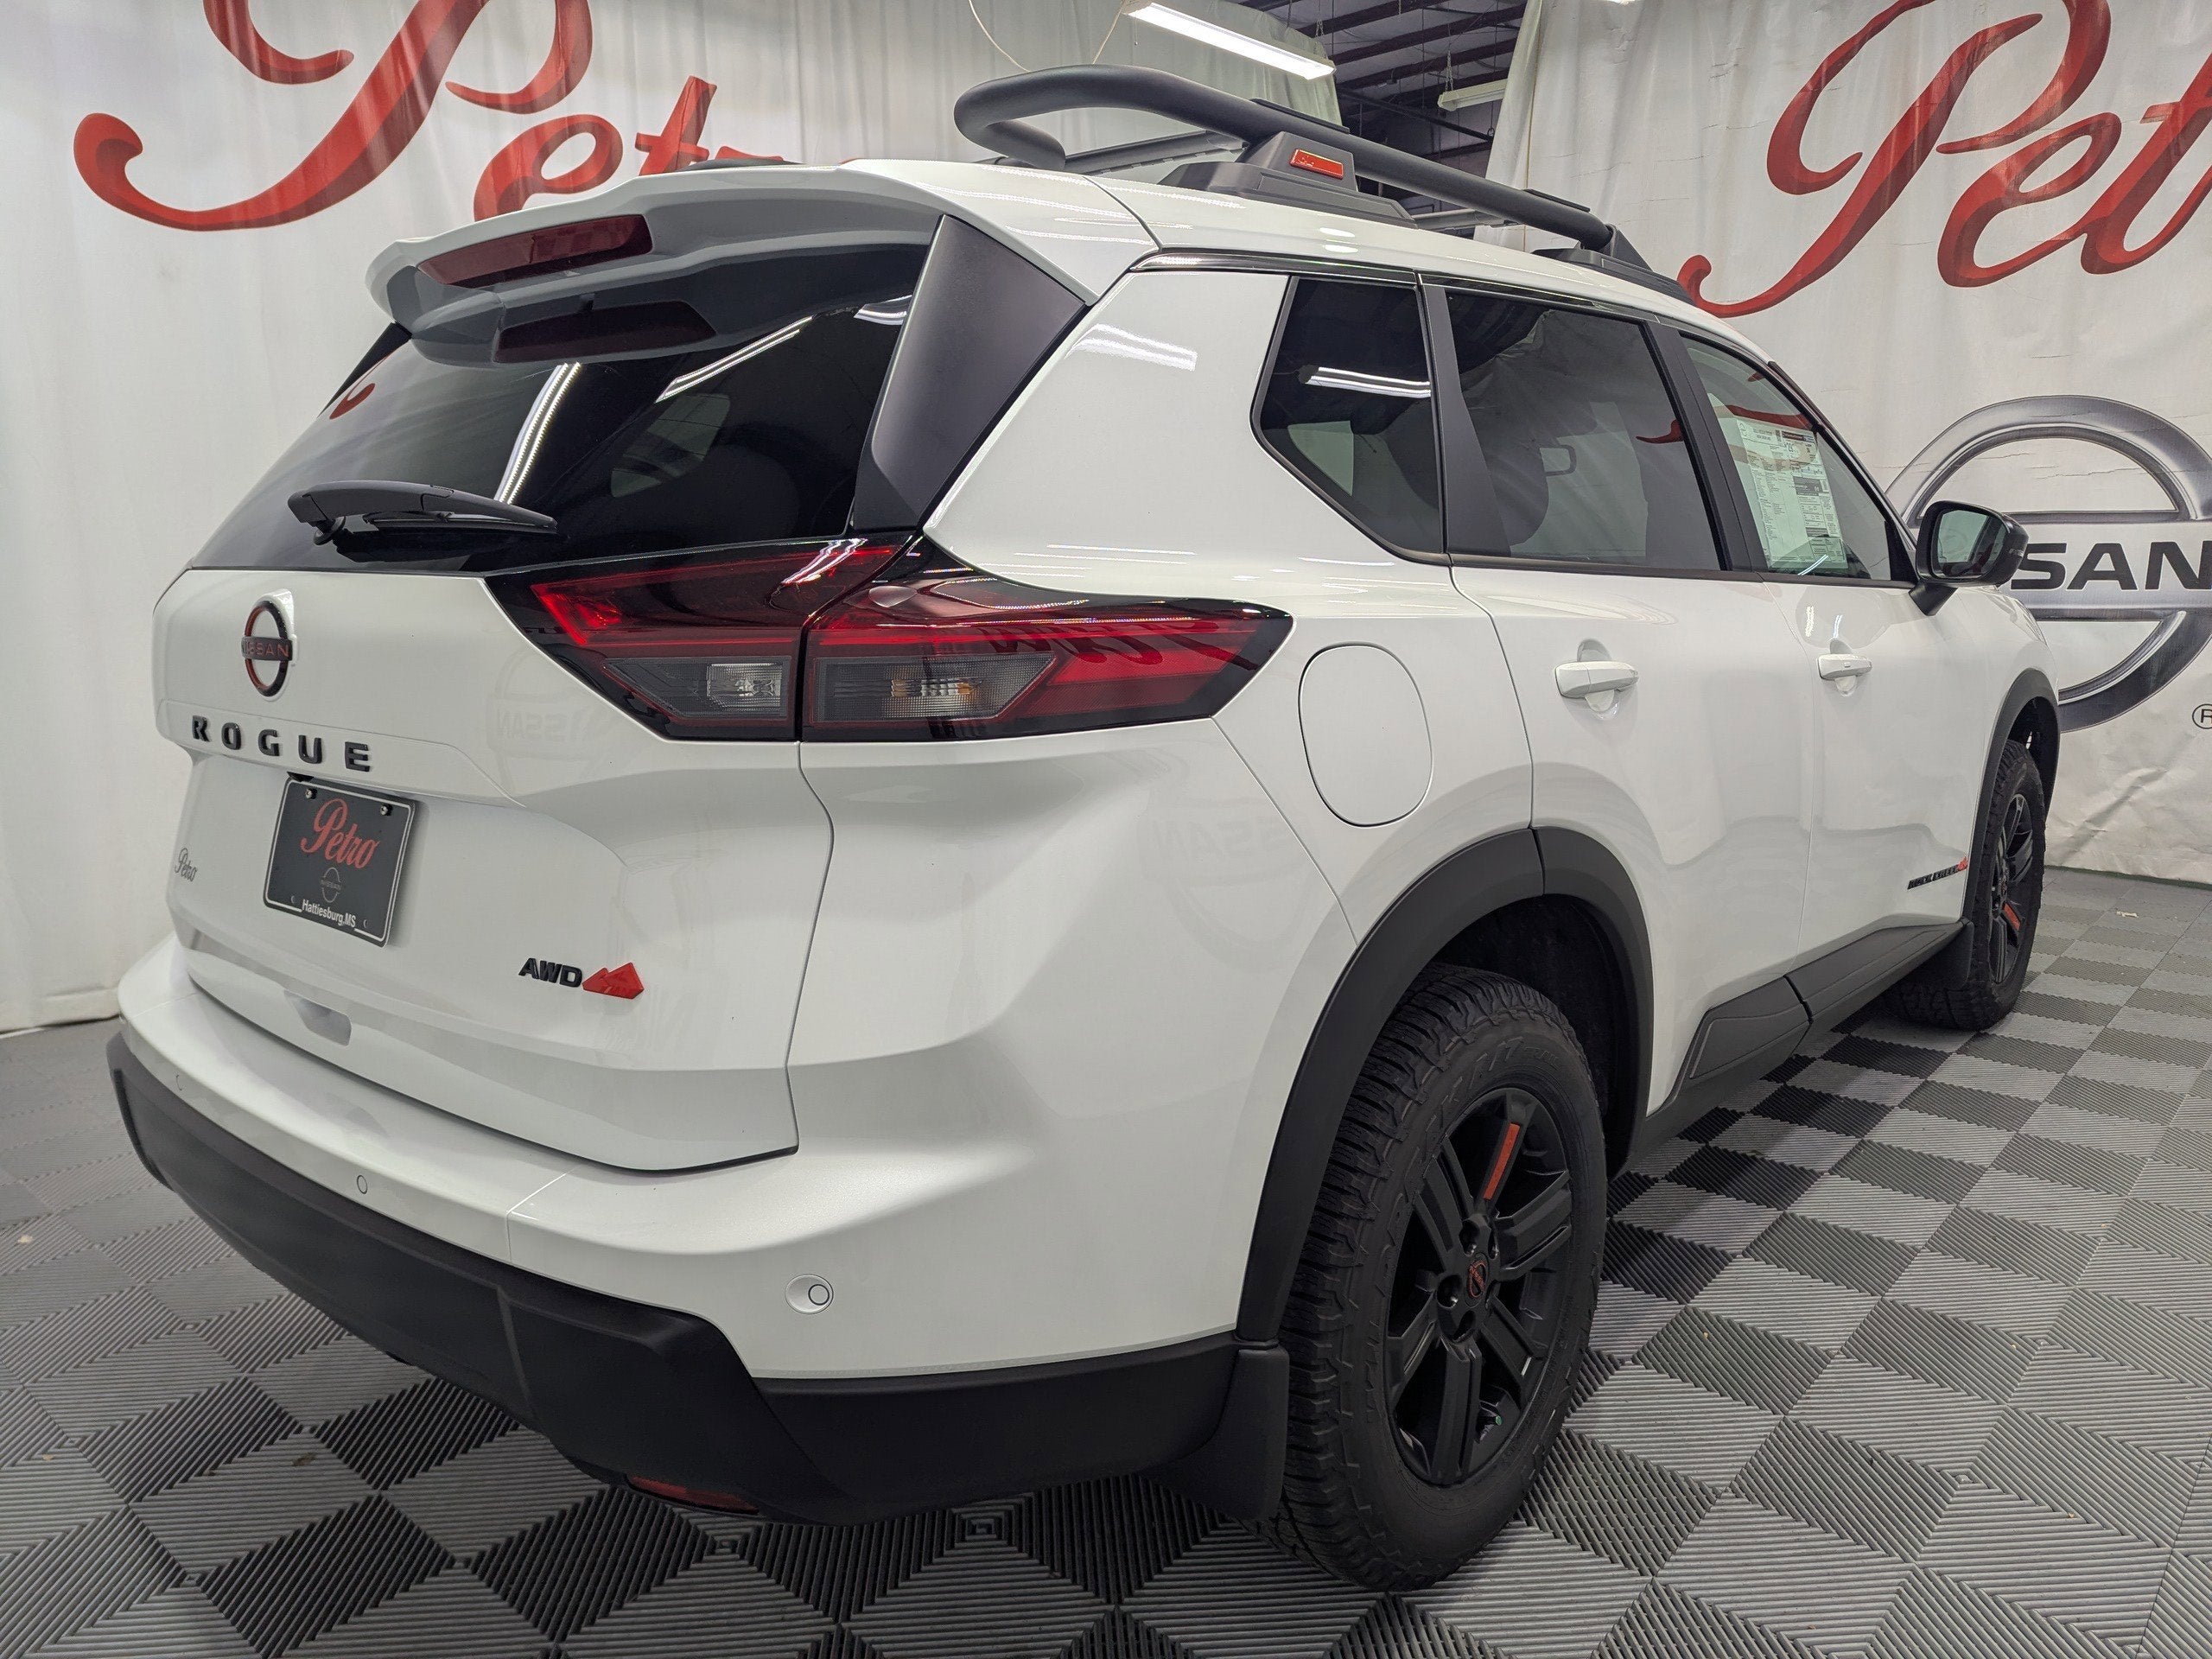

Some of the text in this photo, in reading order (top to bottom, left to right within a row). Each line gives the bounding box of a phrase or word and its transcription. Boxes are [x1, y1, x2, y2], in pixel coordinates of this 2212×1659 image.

[73, 0, 785, 231] Pet
[192, 715, 371, 772] ROGUE
[300, 798, 380, 869] Petro
[174, 847, 198, 882] Petro
[518, 957, 582, 988] AWD
